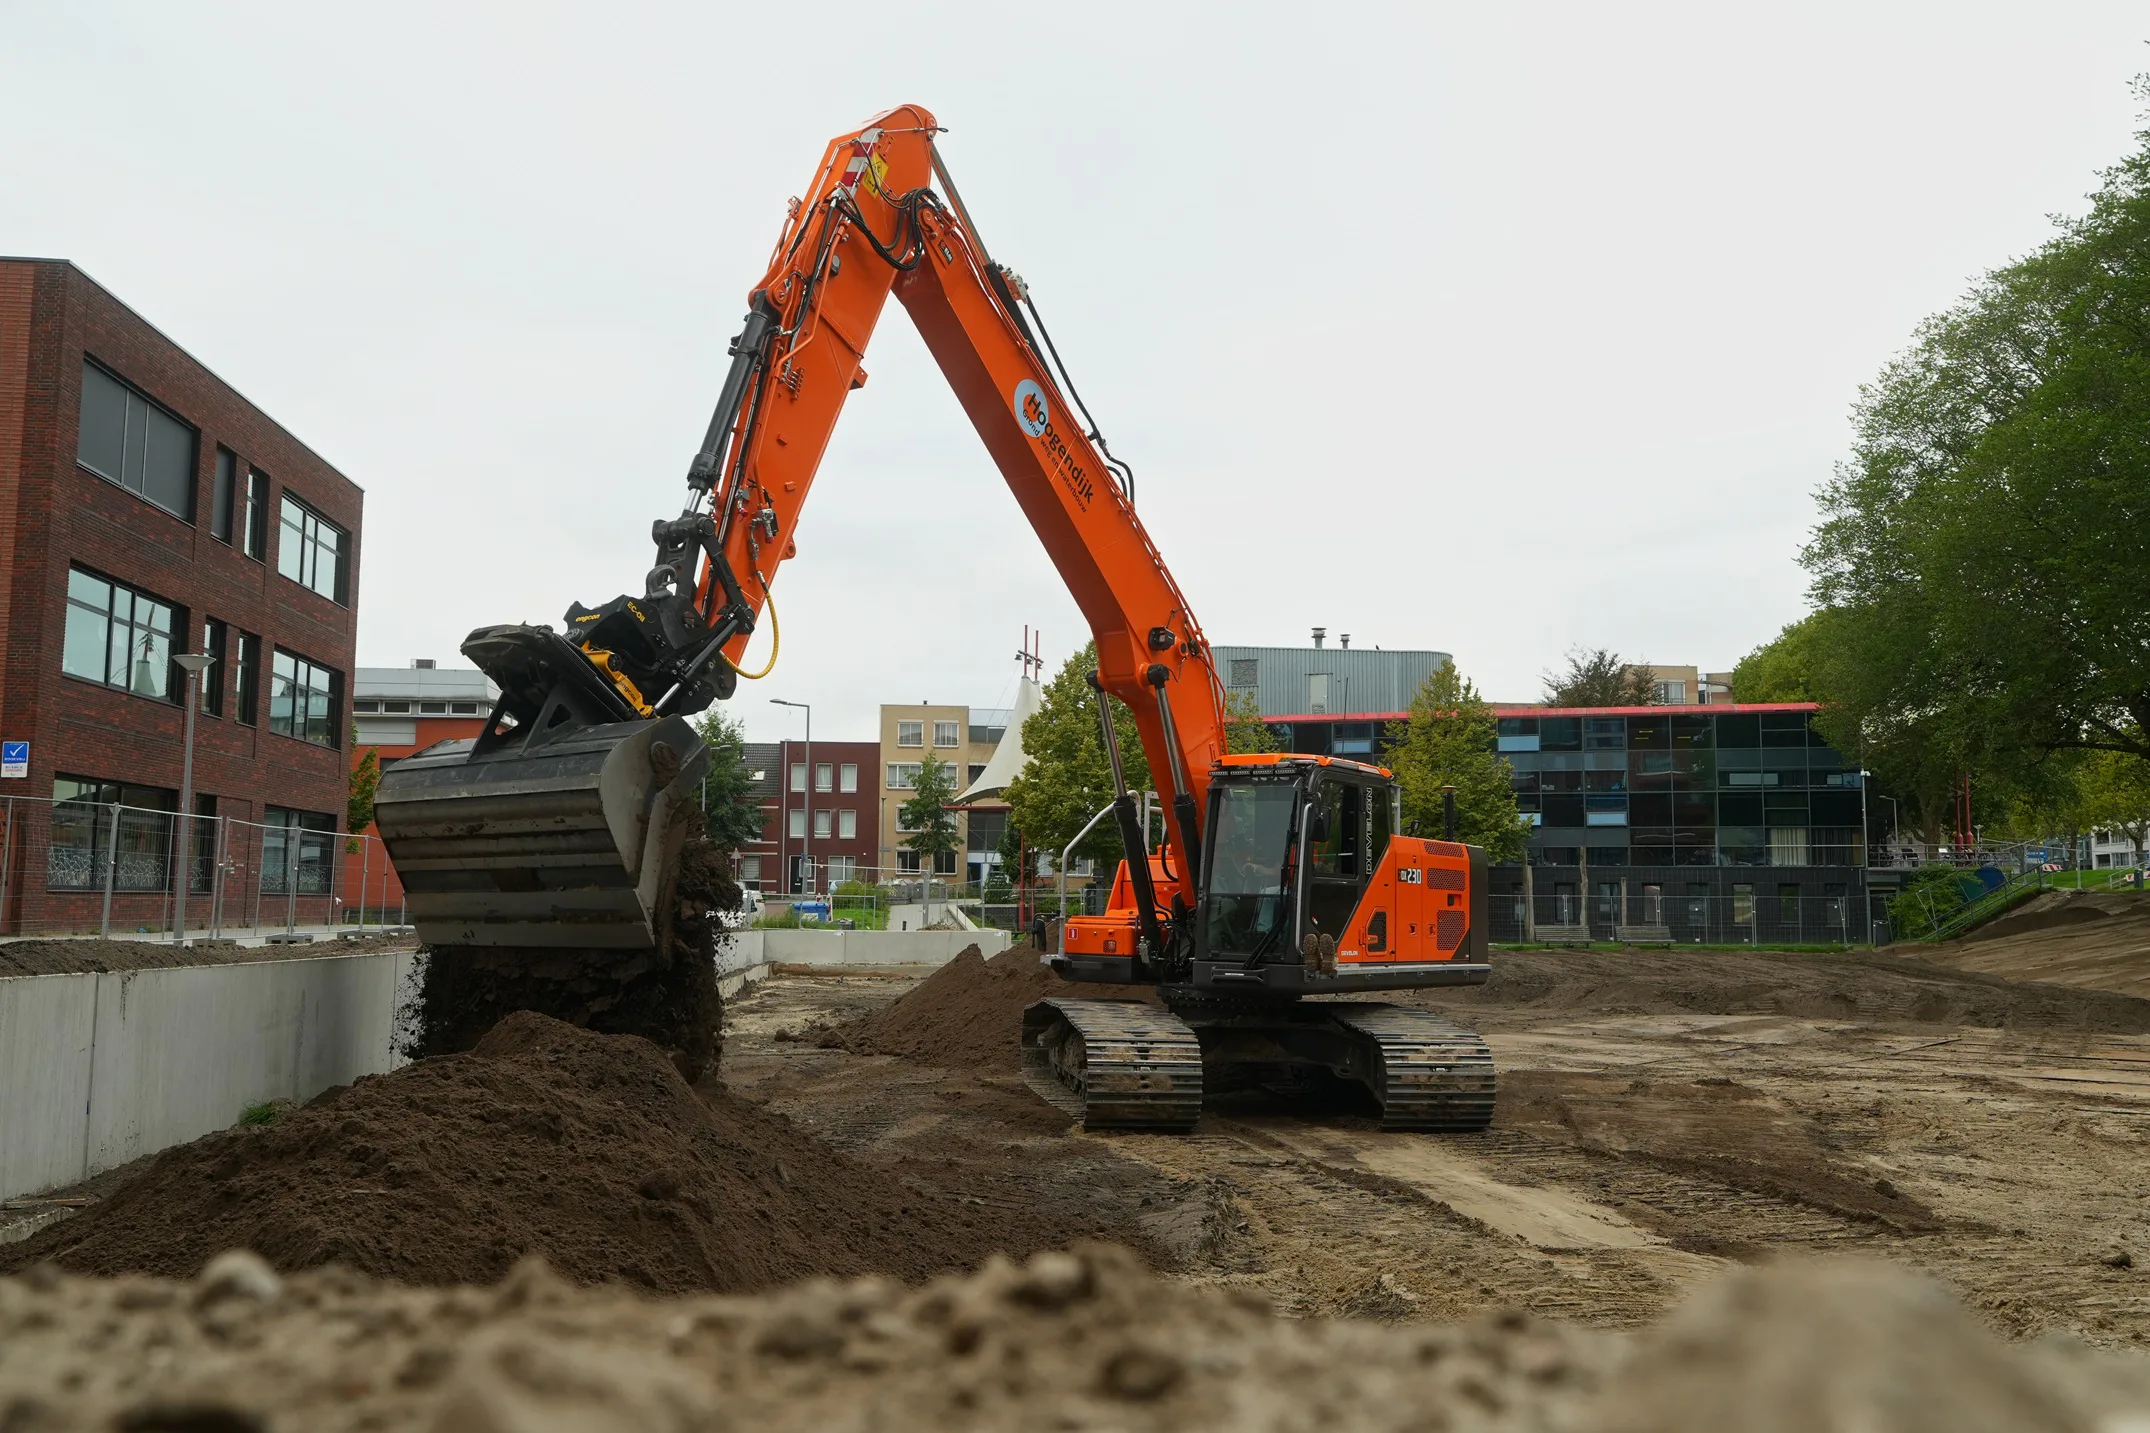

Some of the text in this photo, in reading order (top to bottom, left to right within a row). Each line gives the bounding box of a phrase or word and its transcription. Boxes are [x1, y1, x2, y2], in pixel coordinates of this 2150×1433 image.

[1028, 393, 1094, 504] Hoogendijk
[1040, 439, 1052, 459] weg
[1051, 457, 1060, 469] en
[1059, 469, 1087, 513] waterbouw
[575, 614, 601, 622] engcon
[620, 681, 637, 702] engcon
[1365, 787, 1373, 875] DEVELON
